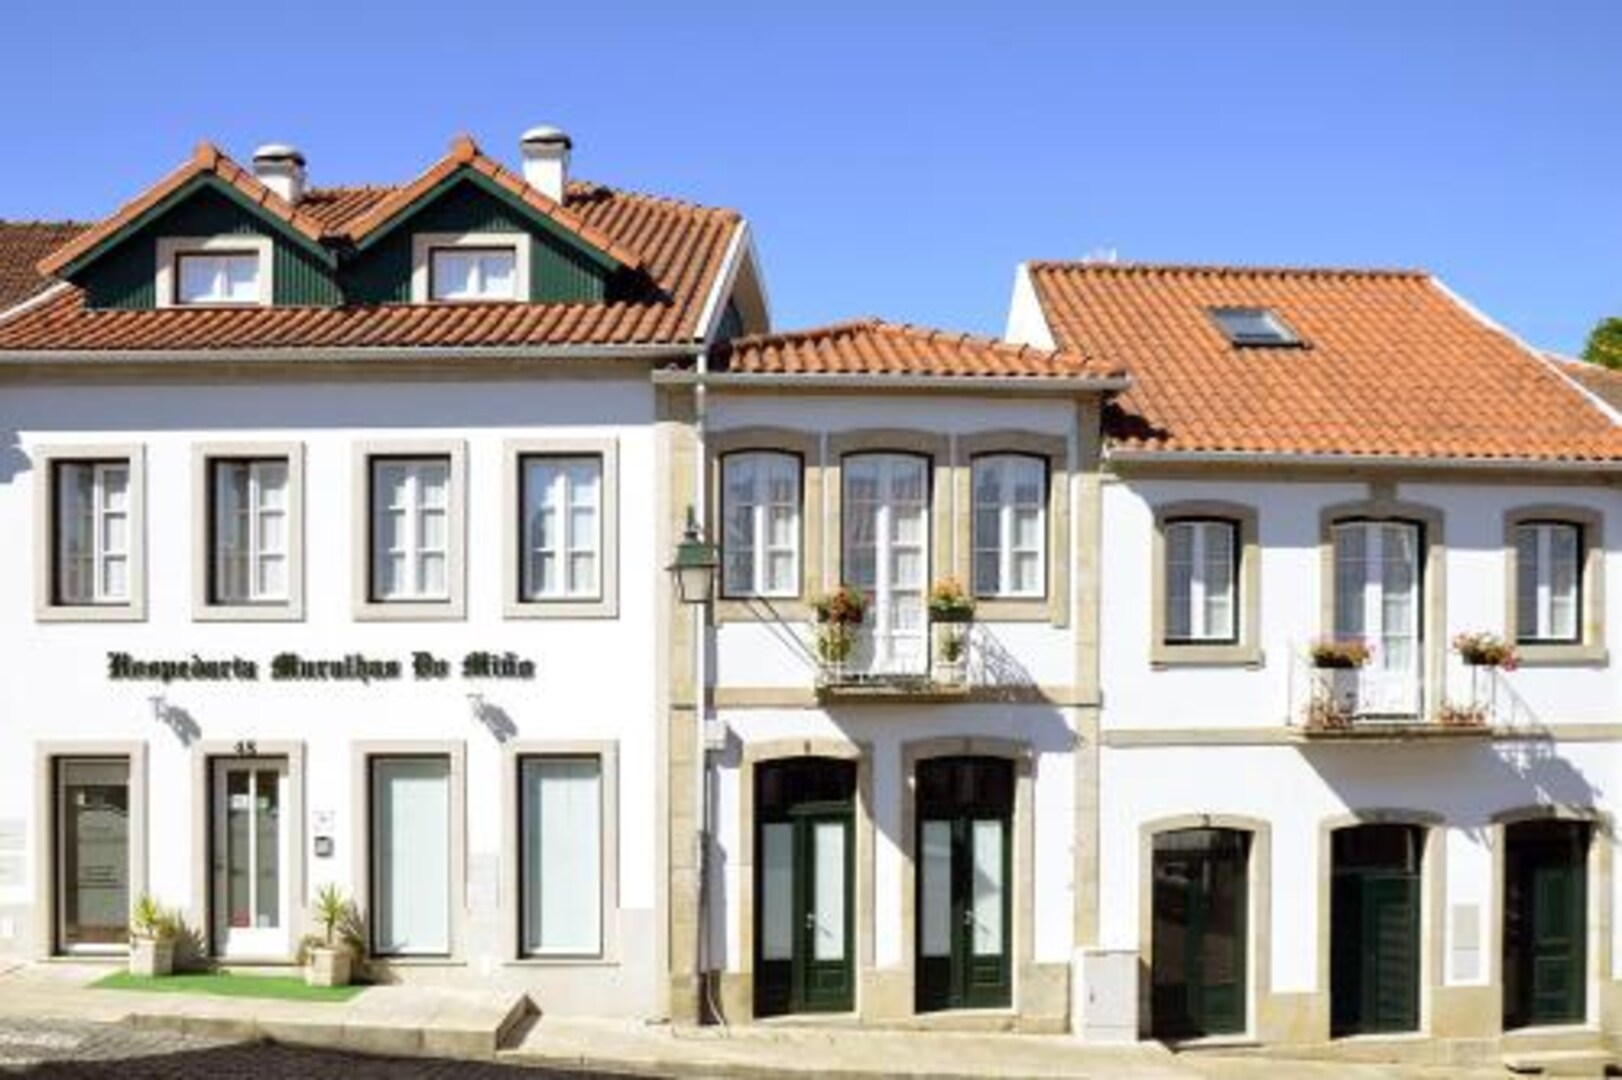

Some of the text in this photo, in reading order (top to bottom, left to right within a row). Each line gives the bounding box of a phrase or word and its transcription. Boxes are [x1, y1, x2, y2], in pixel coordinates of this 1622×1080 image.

[270, 652, 402, 685] Muralhas
[411, 651, 449, 680] Do
[461, 651, 536, 680] Miño
